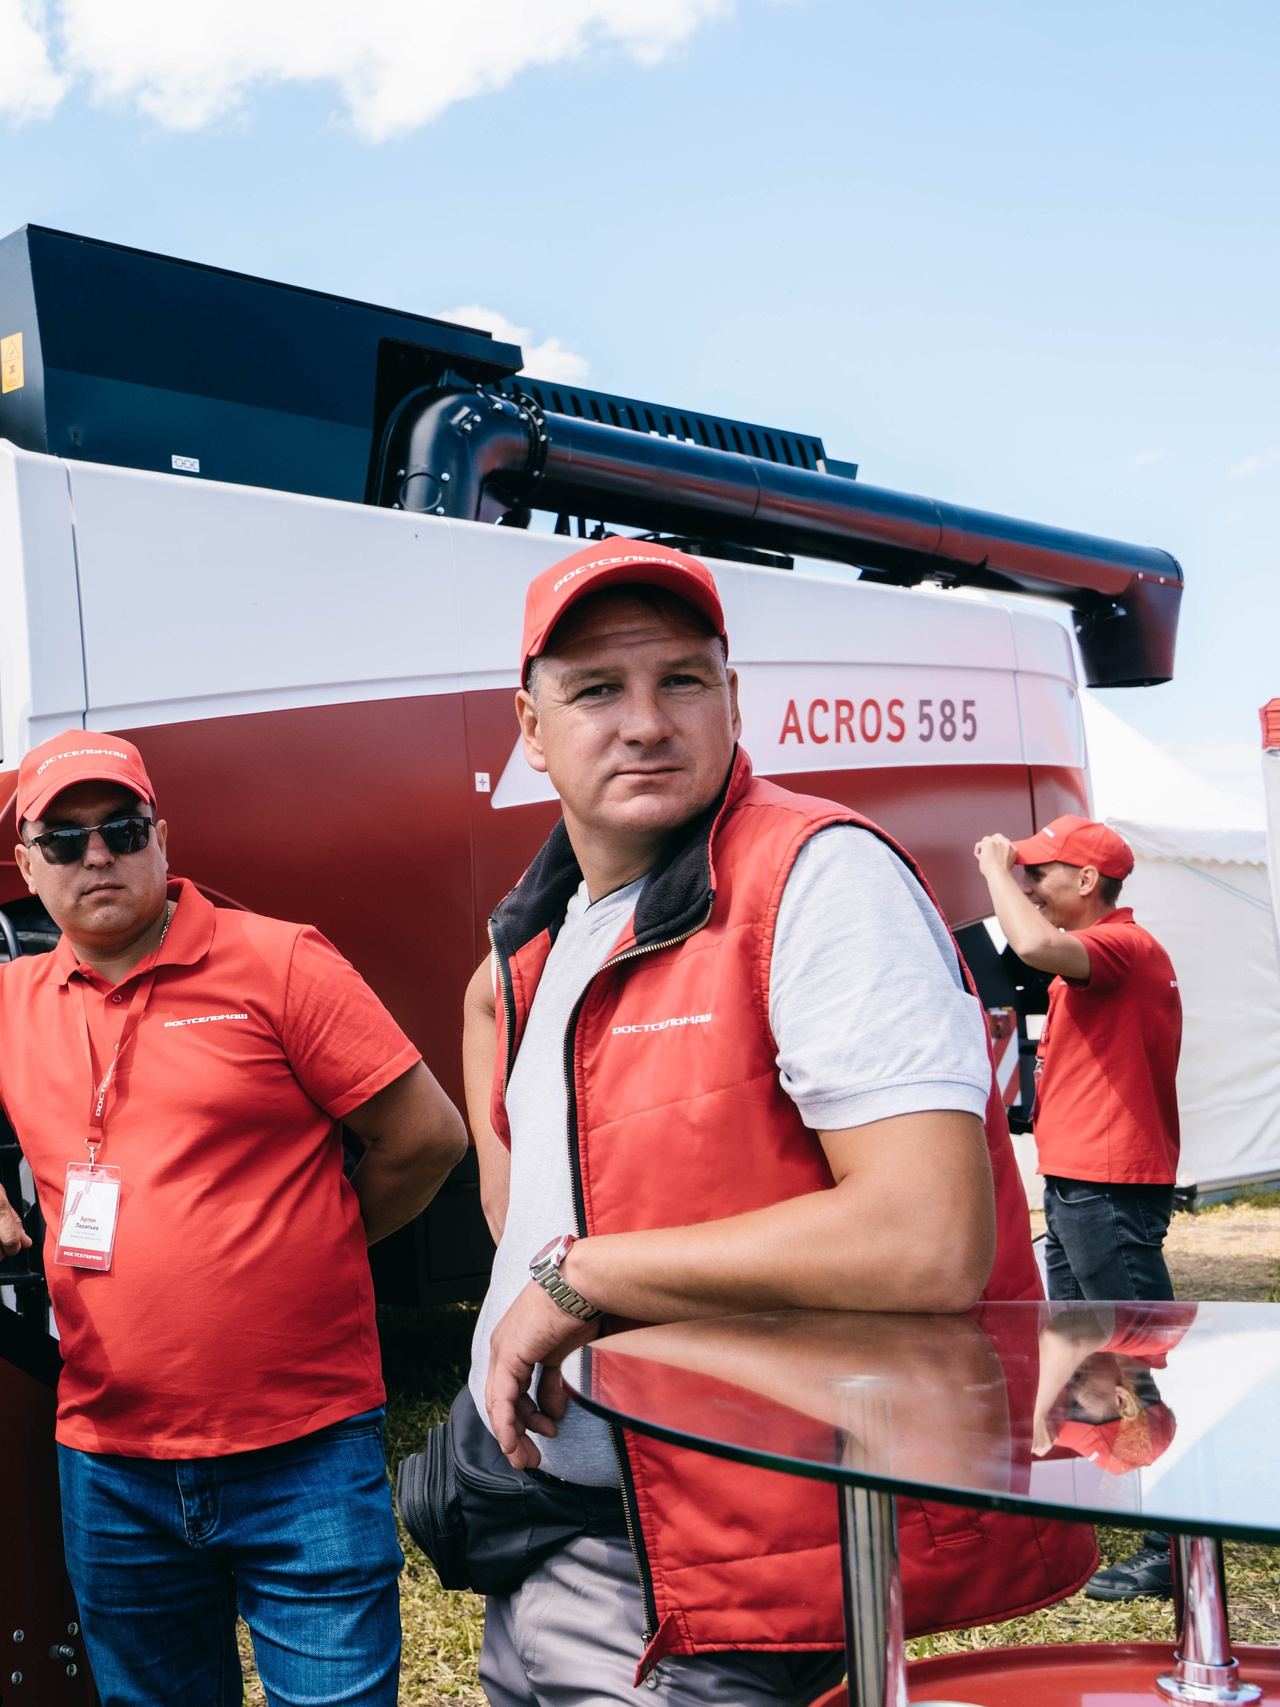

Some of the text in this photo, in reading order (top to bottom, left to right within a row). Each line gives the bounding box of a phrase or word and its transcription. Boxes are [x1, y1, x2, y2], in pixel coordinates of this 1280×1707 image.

[553, 555, 688, 592] РОСТСЕЛЬМ
[778, 698, 978, 745] ACROS 585
[37, 749, 128, 776] РОСТСЕЛЬМАШ
[164, 1013, 248, 1028] РОСТСЕЛЬМАШ
[612, 1012, 712, 1036] РОСТСЕЛЬМАШ
[63, 1250, 103, 1261] РОСТСЕЛЬМАШ
